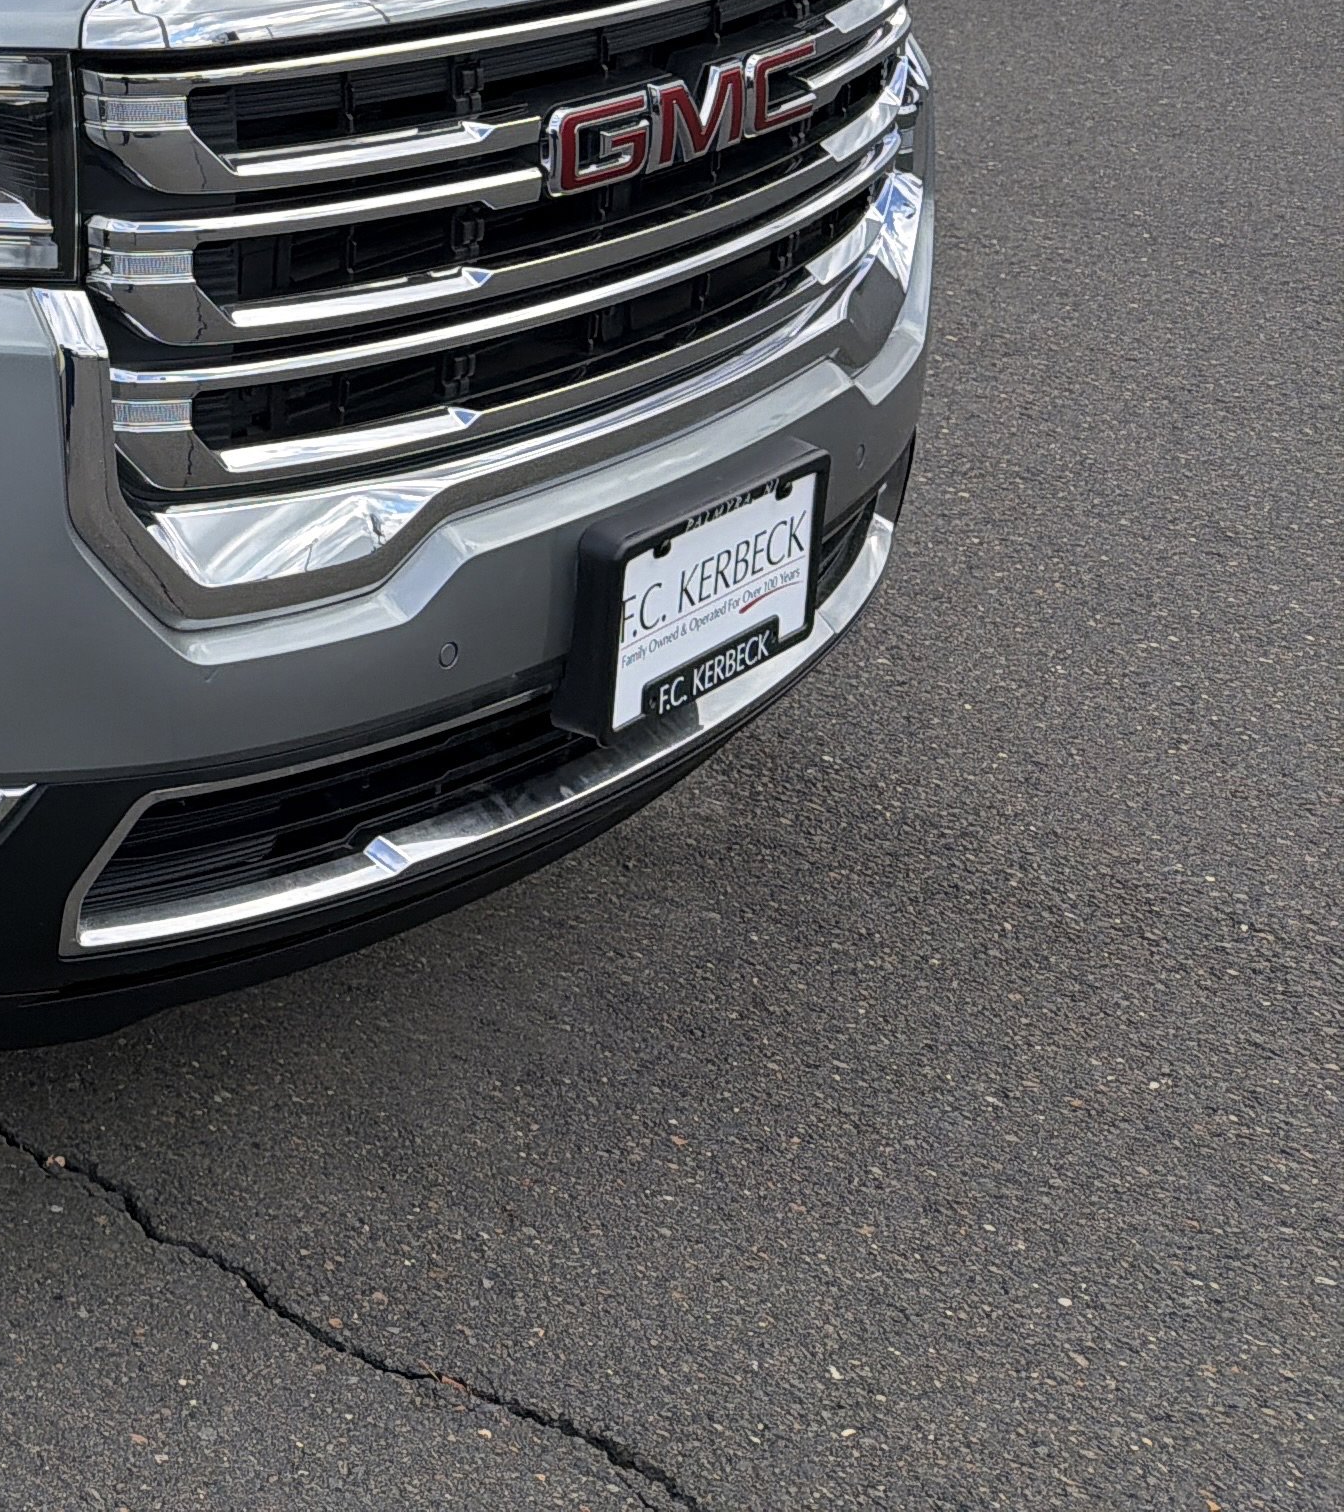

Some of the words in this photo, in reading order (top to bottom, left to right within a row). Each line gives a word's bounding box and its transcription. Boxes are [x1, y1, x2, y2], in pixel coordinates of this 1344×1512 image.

[540, 38, 817, 198] GMC
[677, 510, 808, 614] KERBECK
[621, 644, 646, 669] Family
[648, 629, 680, 654] Owned
[680, 624, 688, 637] &
[688, 606, 727, 633] Operated
[727, 595, 741, 613] For
[742, 585, 762, 604] Over
[763, 576, 778, 594] 100
[779, 567, 800, 586] Years
[658, 676, 688, 715] F.C.
[692, 629, 772, 696] KERBECK
